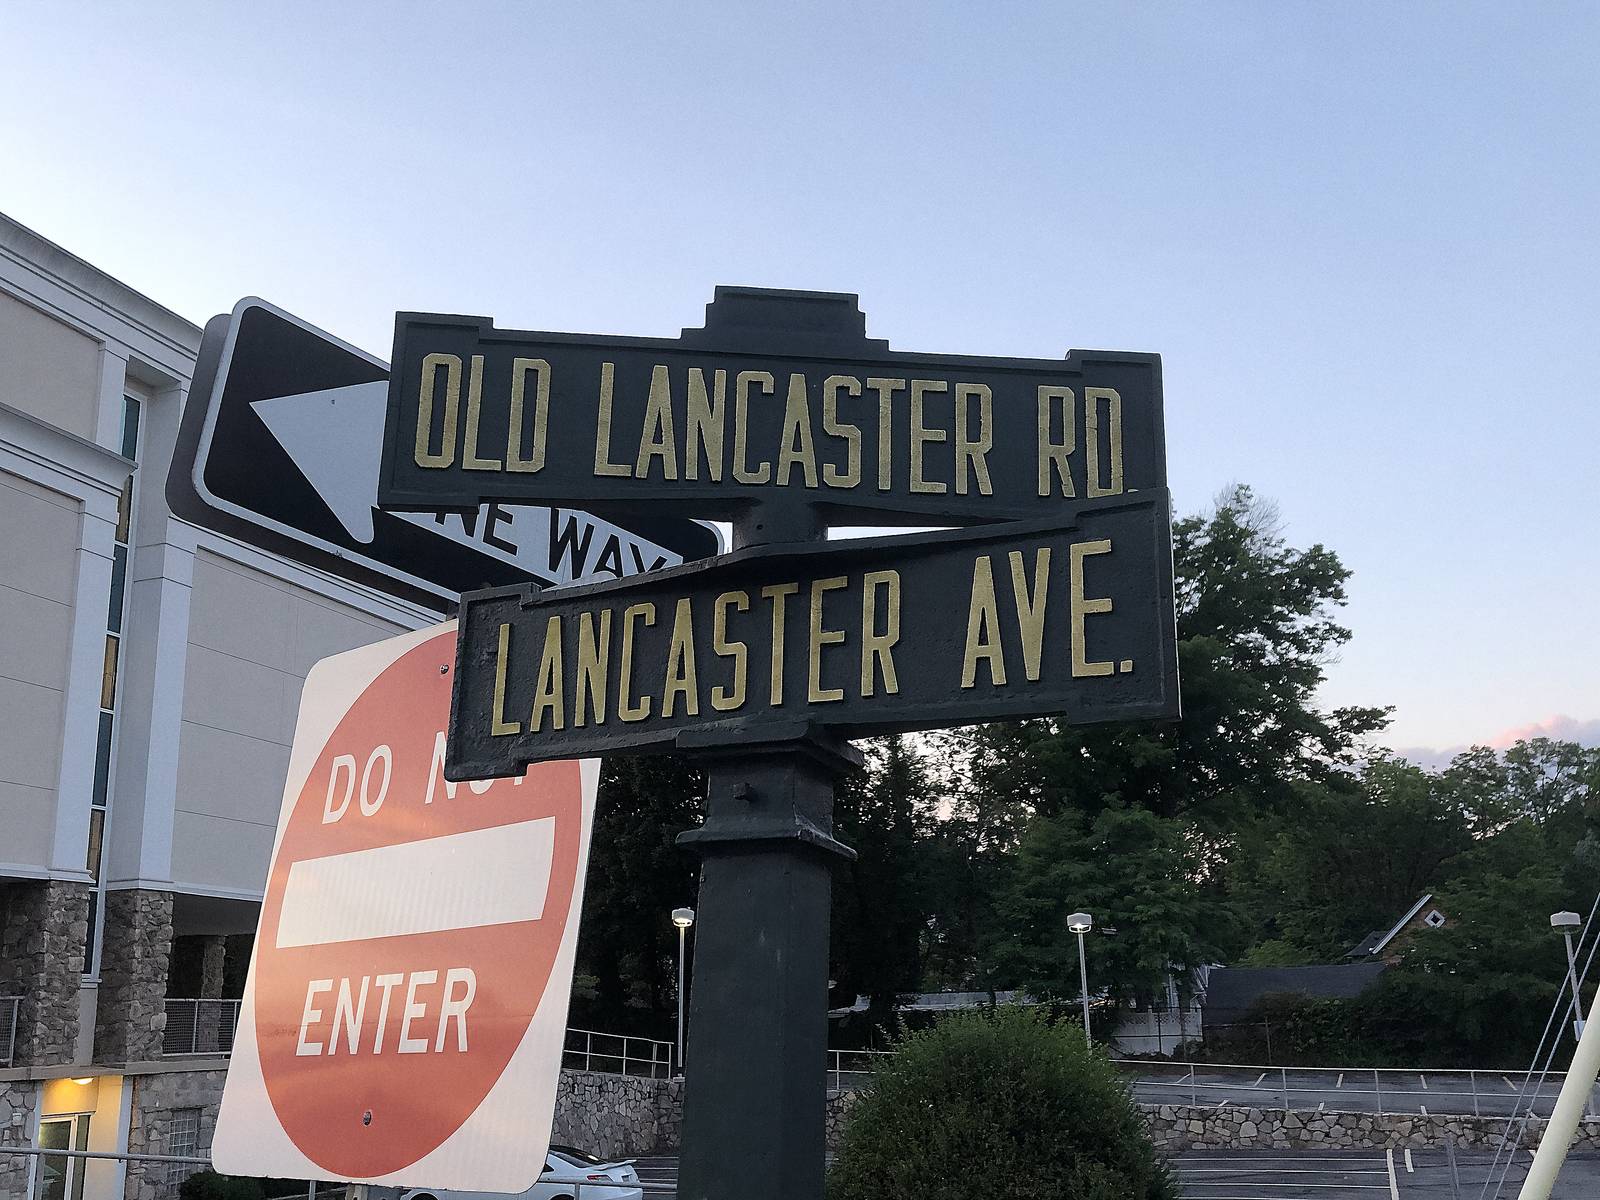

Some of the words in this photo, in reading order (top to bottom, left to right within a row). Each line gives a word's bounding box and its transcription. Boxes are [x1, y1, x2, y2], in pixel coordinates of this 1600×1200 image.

[414, 353, 551, 473] OLD
[594, 362, 993, 495] LANCASTER
[491, 569, 901, 736] LANCASTER
[960, 539, 1133, 688] AVE.
[322, 744, 393, 824] DO
[295, 967, 478, 1056] ENTER
